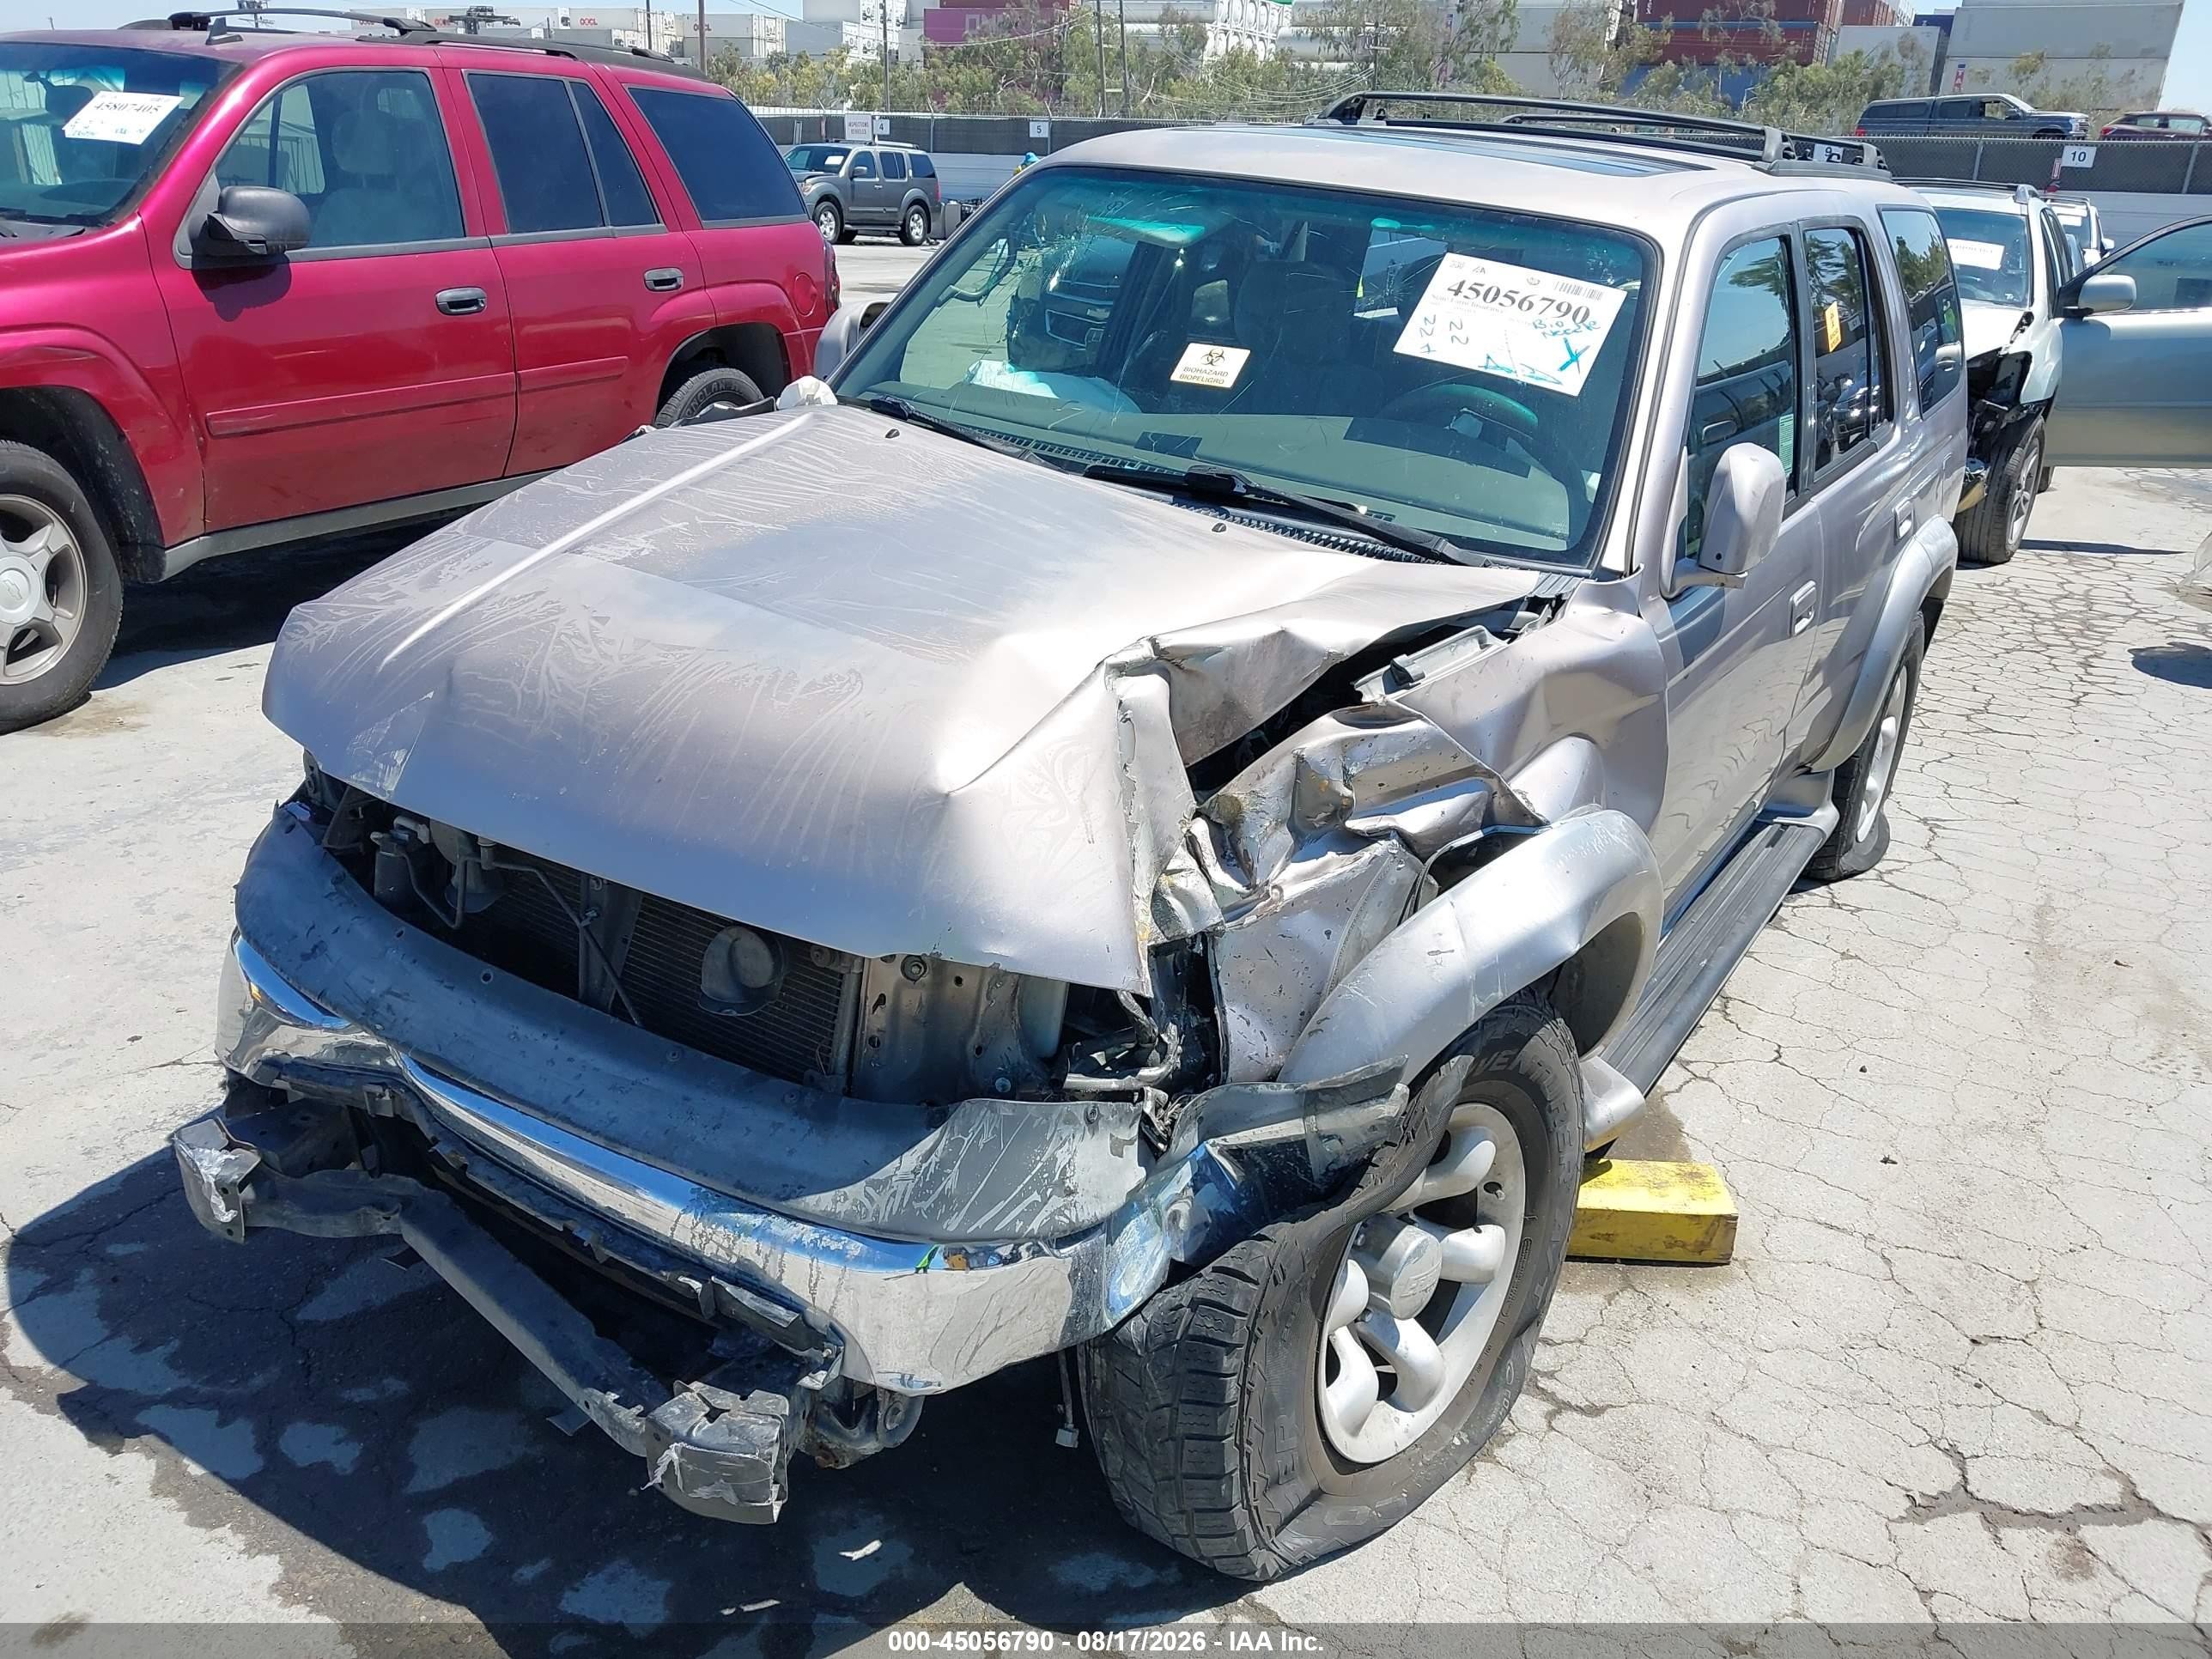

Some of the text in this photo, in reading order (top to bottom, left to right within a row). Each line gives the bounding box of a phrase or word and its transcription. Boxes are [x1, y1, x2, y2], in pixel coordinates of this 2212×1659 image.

[579, 17, 599, 26] OOCL
[692, 22, 712, 32] OCL
[878, 123, 884, 131] 4
[1036, 125, 1042, 134] 5
[2070, 150, 2087, 162] 10
[1447, 279, 1591, 325] 45056790
[1183, 367, 1229, 377] BIOHAZARD
[1180, 374, 1224, 384] BIOPELIGRO
